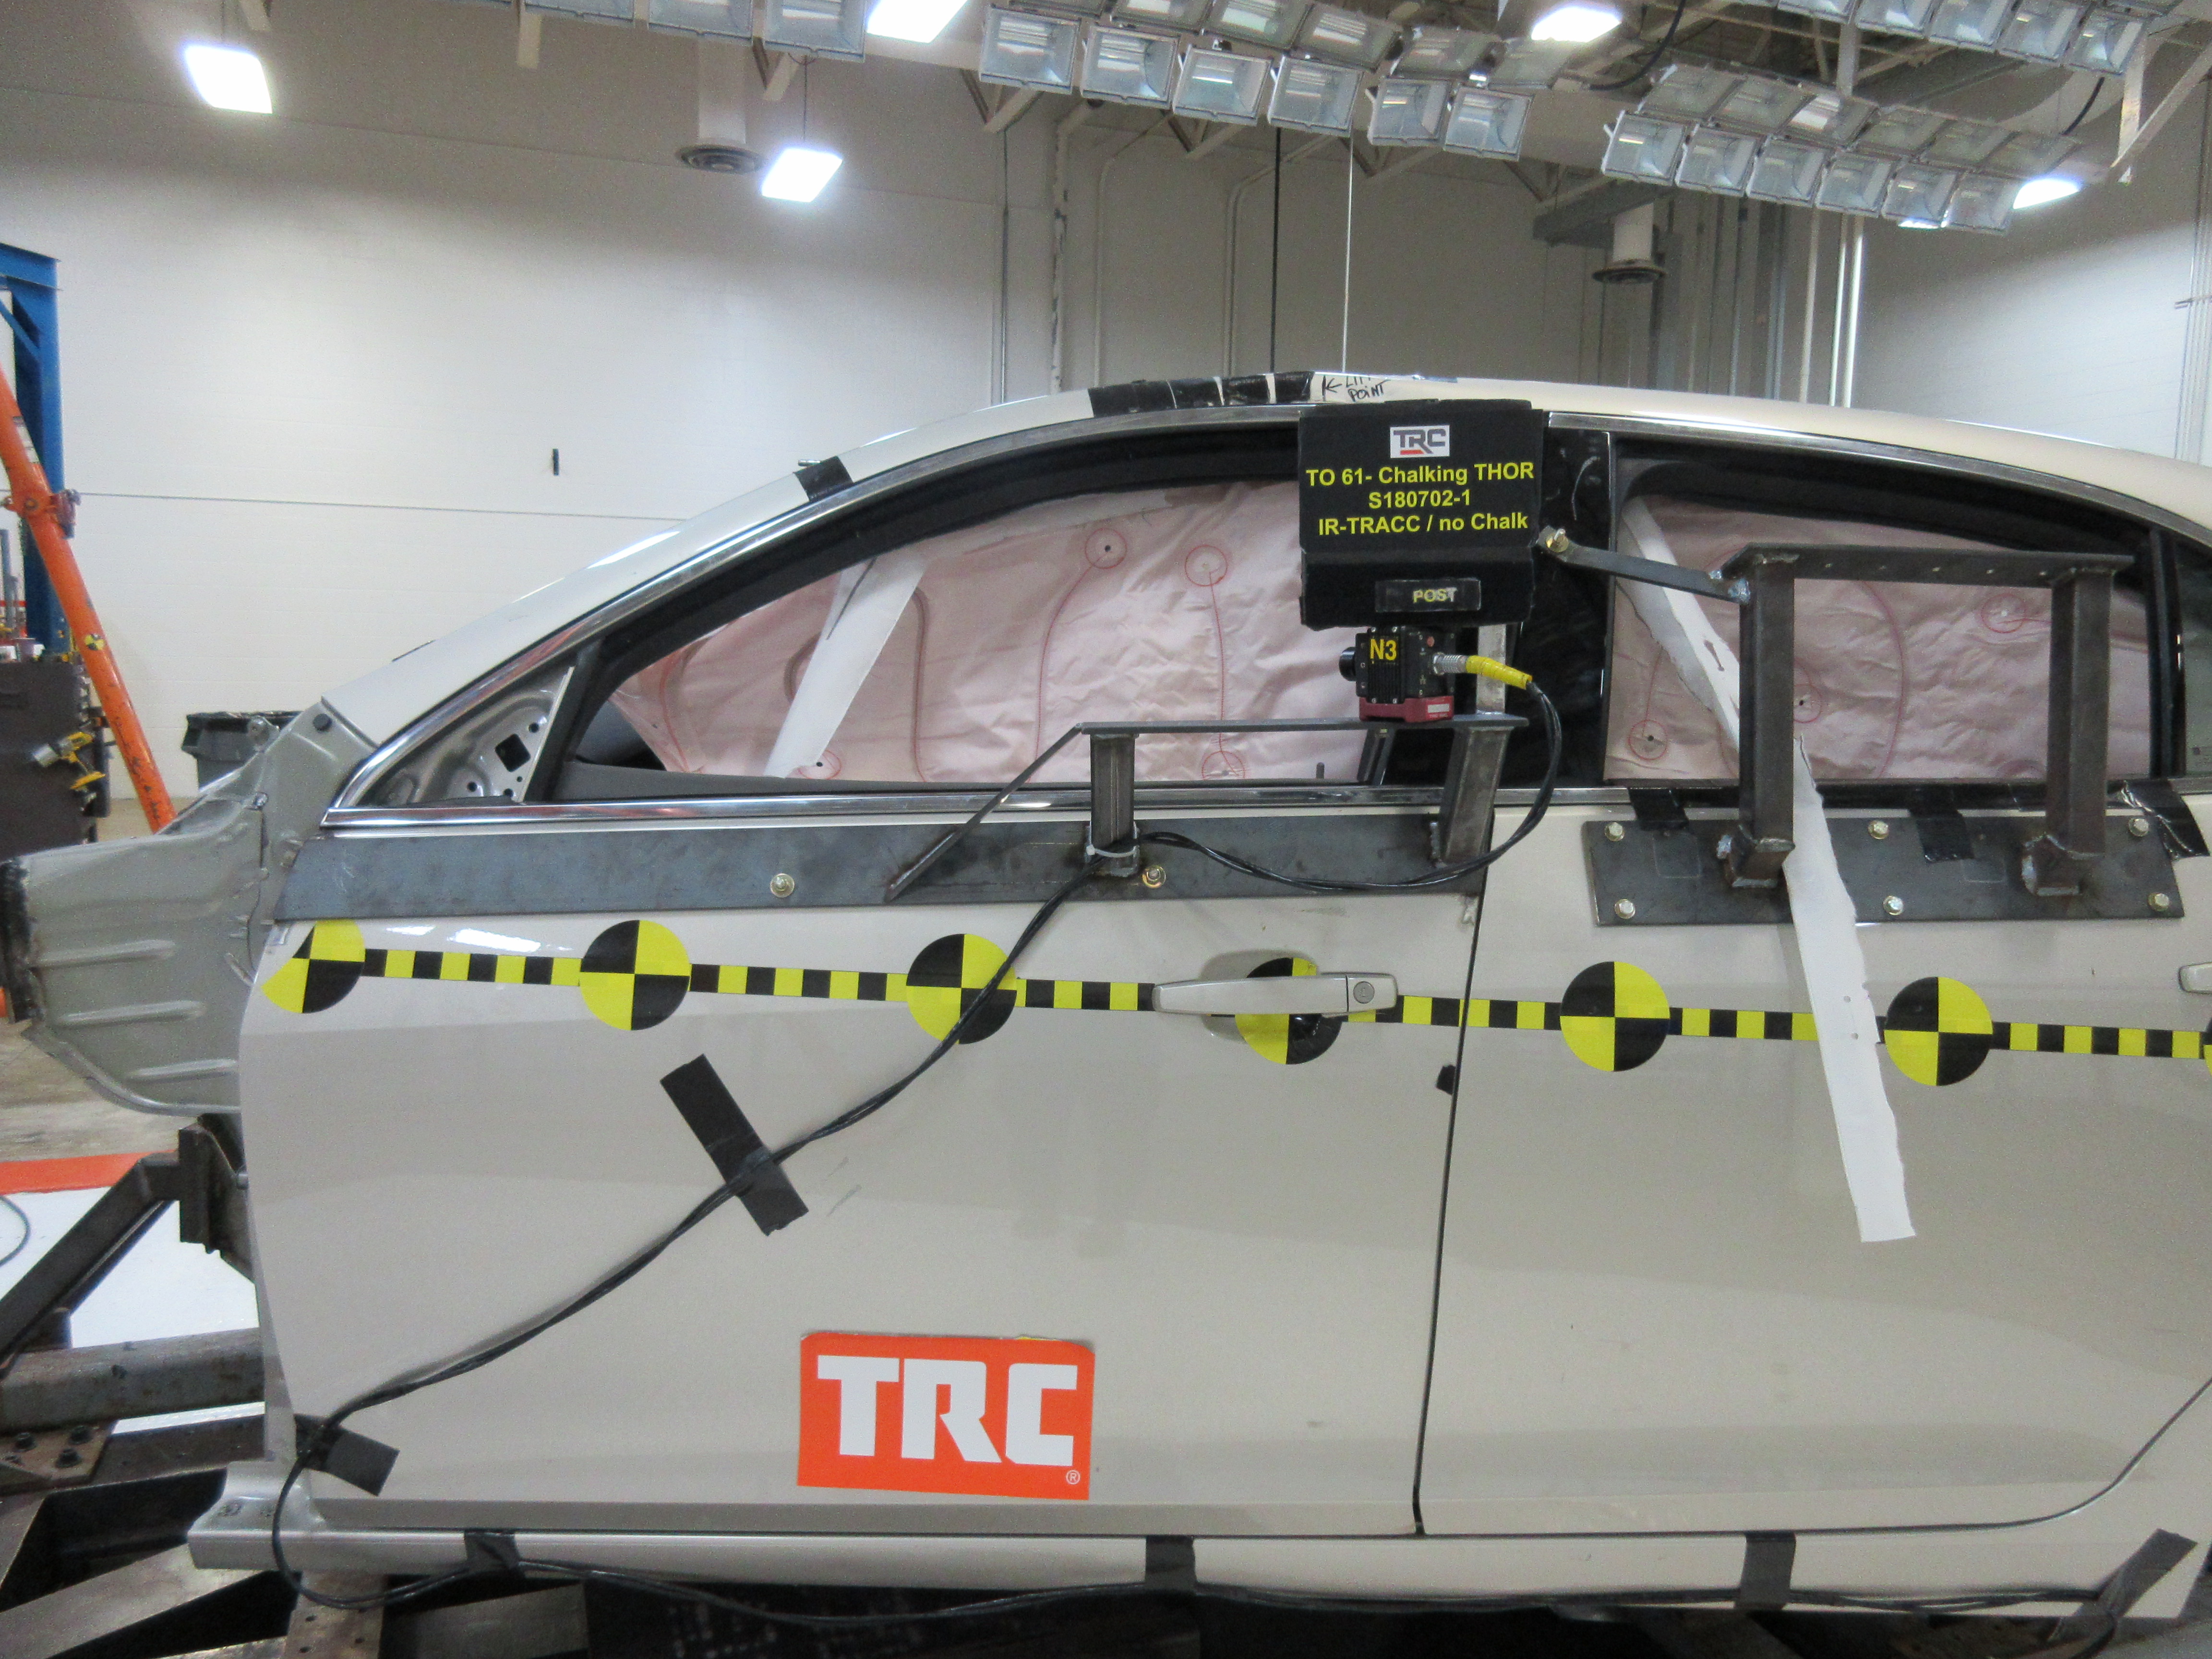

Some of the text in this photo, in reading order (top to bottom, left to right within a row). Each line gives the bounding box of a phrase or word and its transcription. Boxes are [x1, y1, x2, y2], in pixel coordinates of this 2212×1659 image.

[1393, 429, 1446, 454] TRC
[1306, 462, 1534, 486] TO 61- Chalking THOR
[1369, 489, 1470, 509] S180702-1
[1319, 515, 1421, 535] IR-TRACC
[1439, 517, 1465, 531] no
[1471, 512, 1528, 530] Chalk
[1412, 587, 1458, 604] POST
[1370, 638, 1397, 661] N3
[817, 1355, 1078, 1467] TRC
